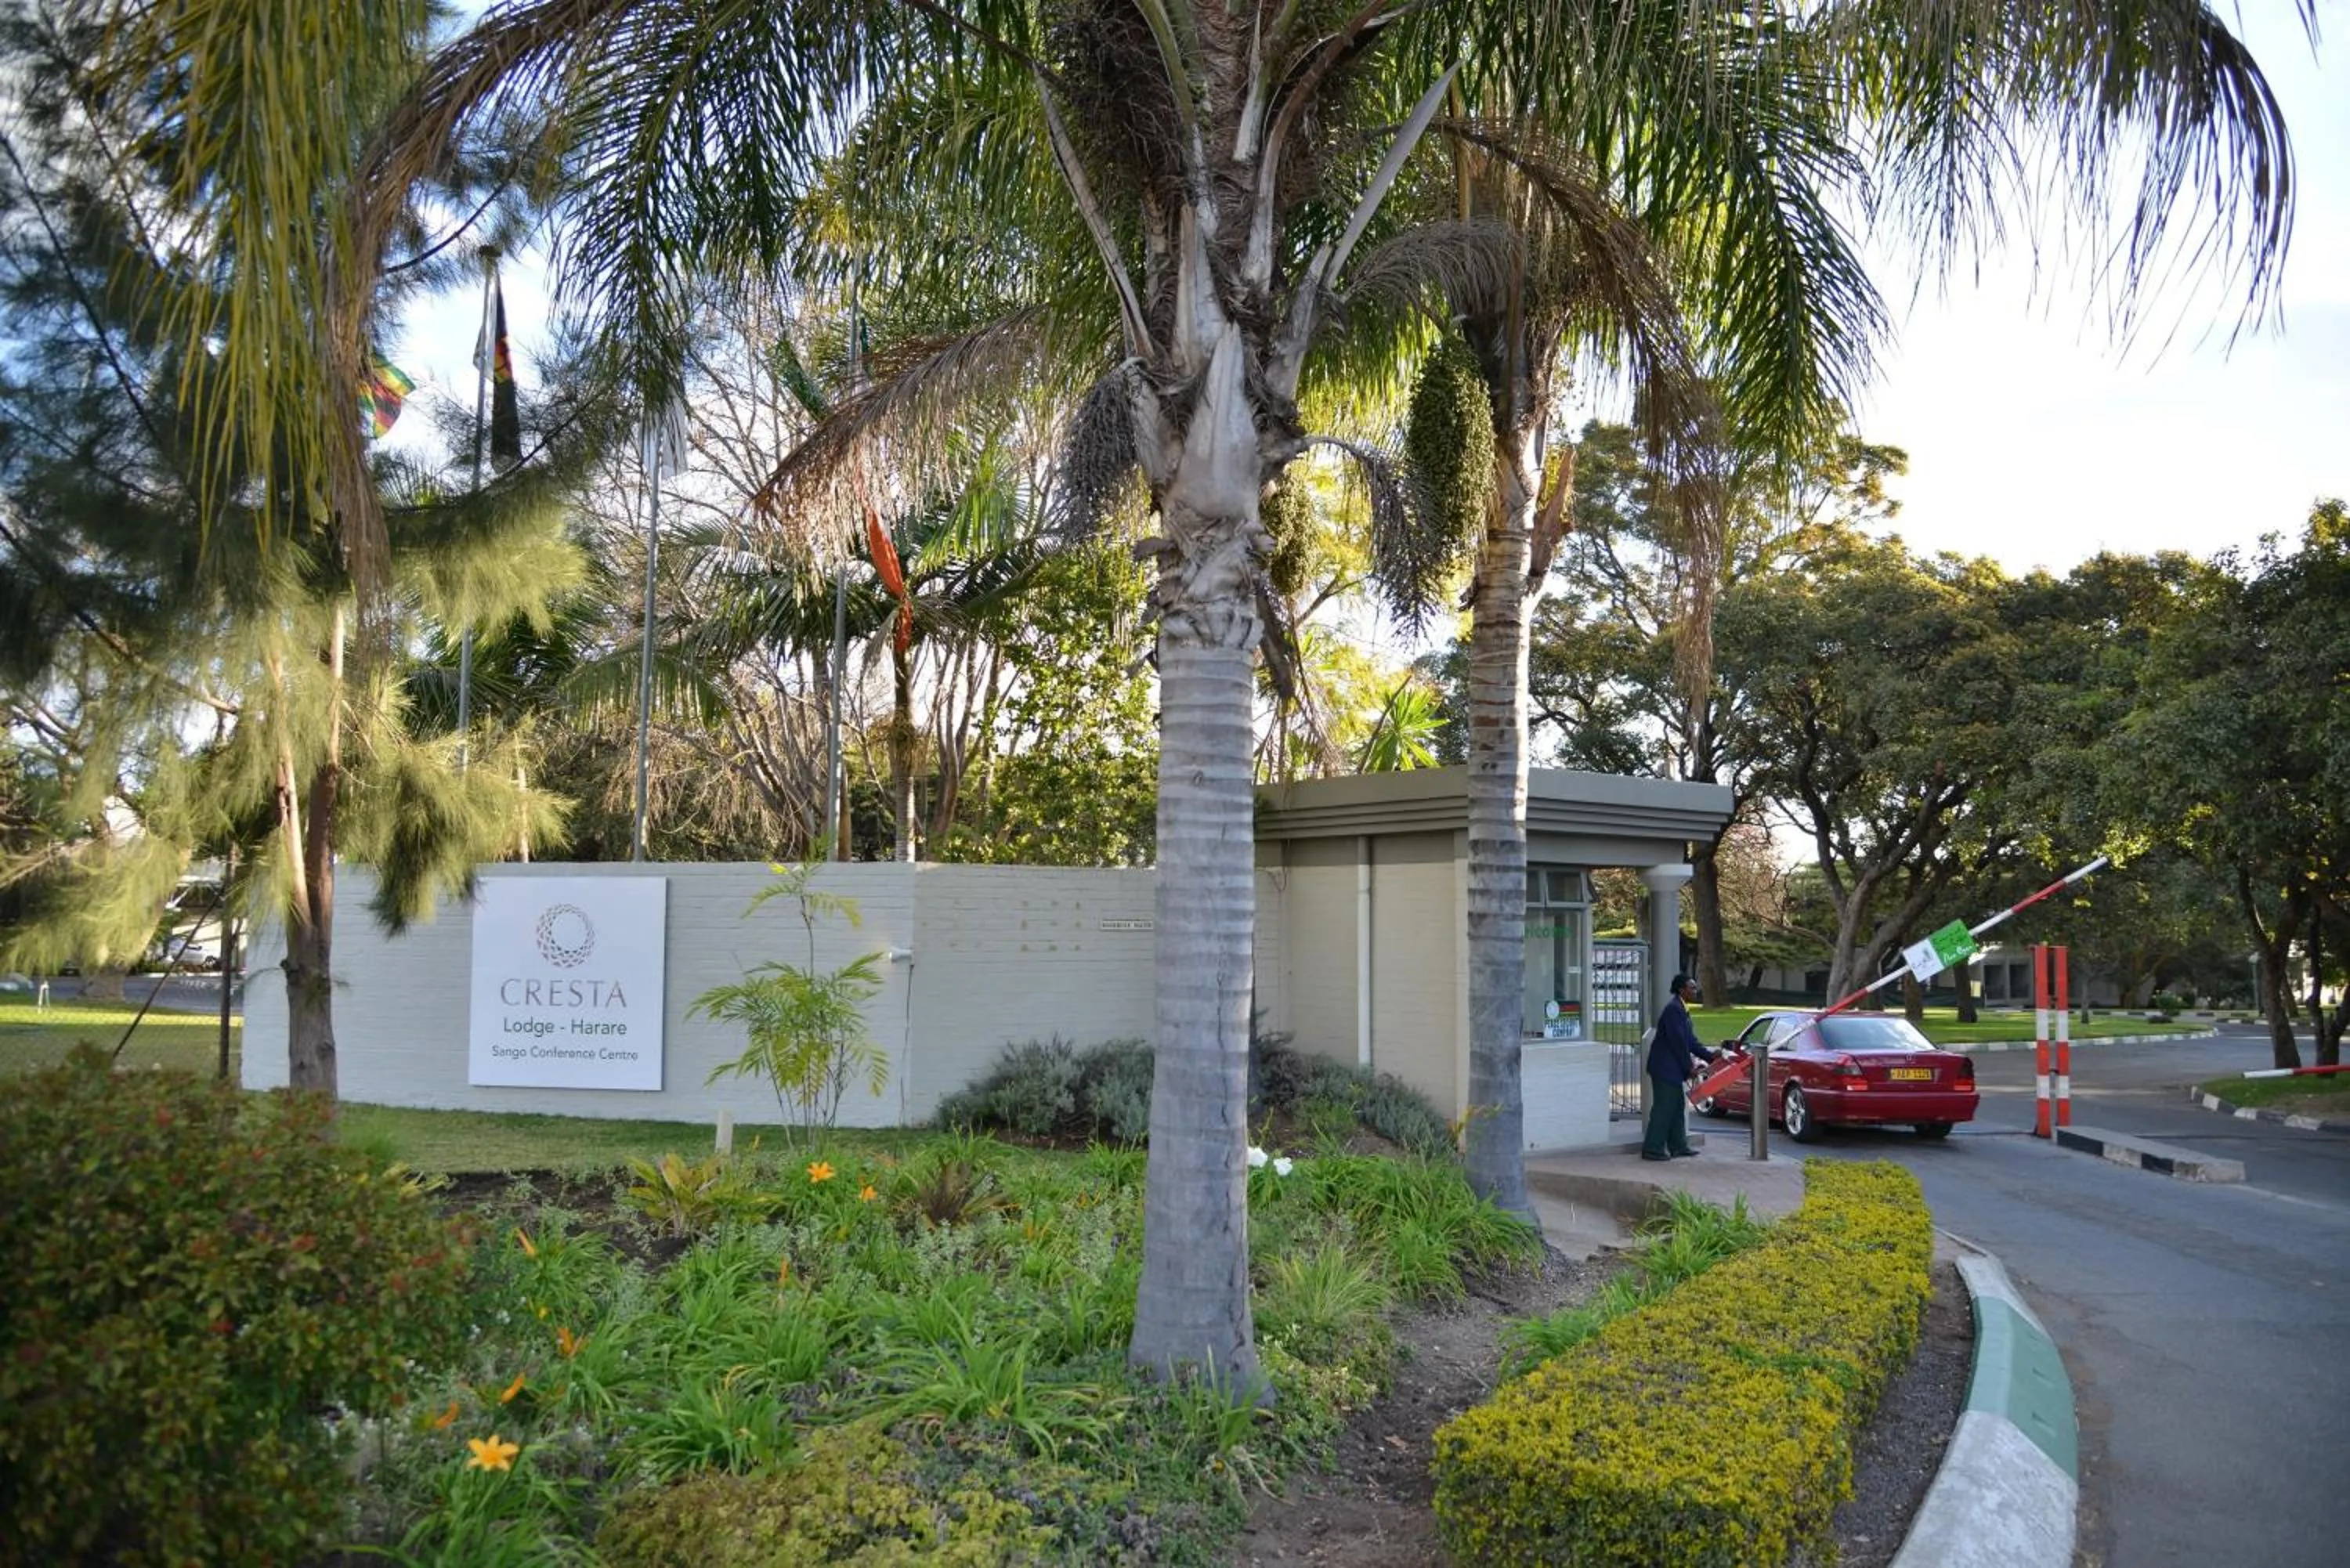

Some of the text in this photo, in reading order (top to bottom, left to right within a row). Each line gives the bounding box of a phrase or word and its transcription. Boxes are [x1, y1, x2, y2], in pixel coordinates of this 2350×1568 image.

[501, 977, 627, 1008] CRESTA
[504, 1016, 555, 1038] Lodge
[570, 1018, 627, 1035] Harare
[491, 1044, 639, 1060] Sango Conference Centre
